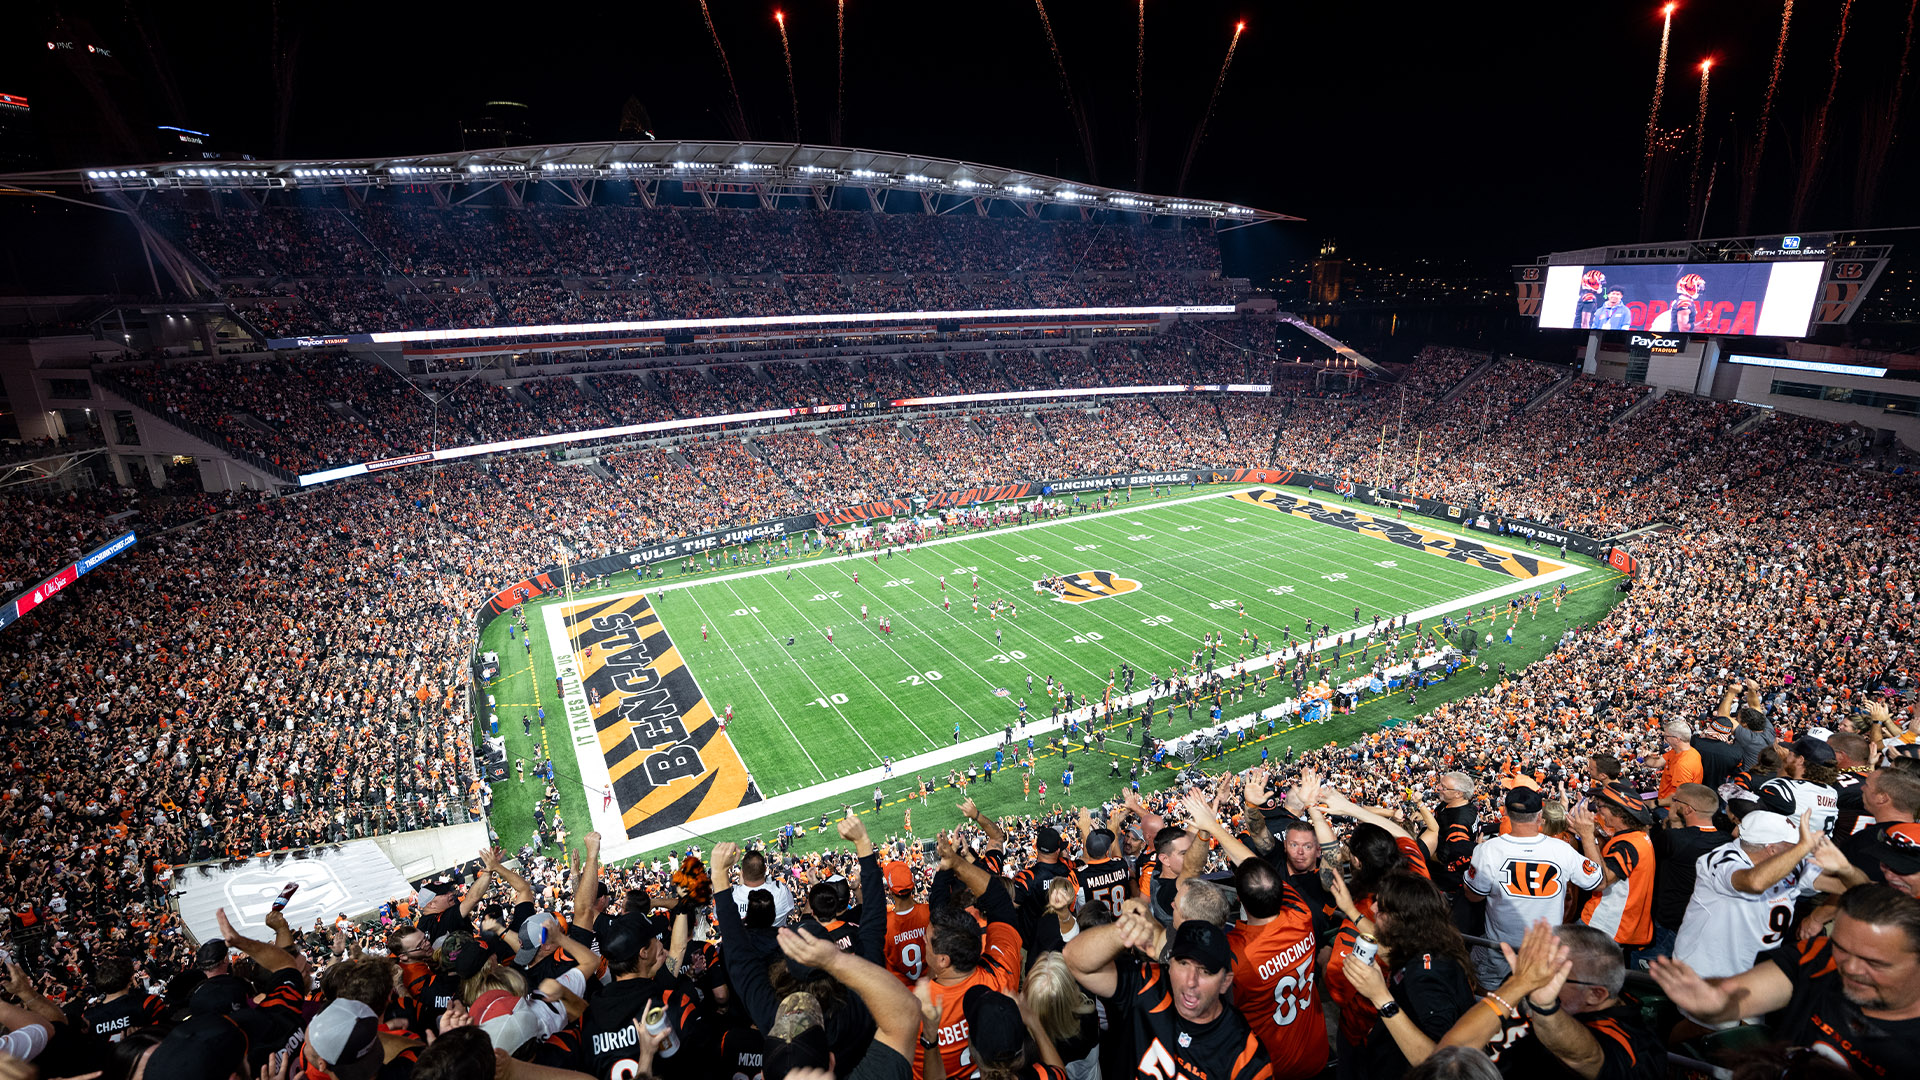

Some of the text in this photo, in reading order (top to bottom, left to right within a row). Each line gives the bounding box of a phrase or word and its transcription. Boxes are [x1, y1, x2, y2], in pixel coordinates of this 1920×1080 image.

[1631, 335, 1680, 349] Paycor
[1051, 473, 1188, 490] CINCINNATI BENGALS
[1507, 523, 1568, 545] WHO DEY!
[629, 523, 785, 564] RULE THE JUNGLE
[1321, 572, 1349, 582] 20
[1267, 585, 1295, 595] 30
[1208, 600, 1237, 610] 40
[1140, 615, 1173, 627] 50
[1072, 632, 1104, 644] 40
[557, 655, 572, 665] US
[996, 650, 1028, 664] 30
[564, 679, 581, 695] ALL
[906, 670, 943, 687] 20
[590, 612, 708, 787] BENGALS
[815, 693, 850, 708] 10
[568, 699, 590, 731] TAKES
[577, 735, 595, 746] IT
[1087, 868, 1127, 888] MAUALUGA
[1092, 885, 1125, 917] 58
[1762, 905, 1791, 944] 9
[894, 927, 925, 944] BURROW
[902, 943, 922, 980] 9
[1258, 931, 1315, 980] OCHOCINCO
[1273, 954, 1314, 1026] 85
[96, 1016, 130, 1034] CHASE
[593, 1025, 639, 1056] BURRO
